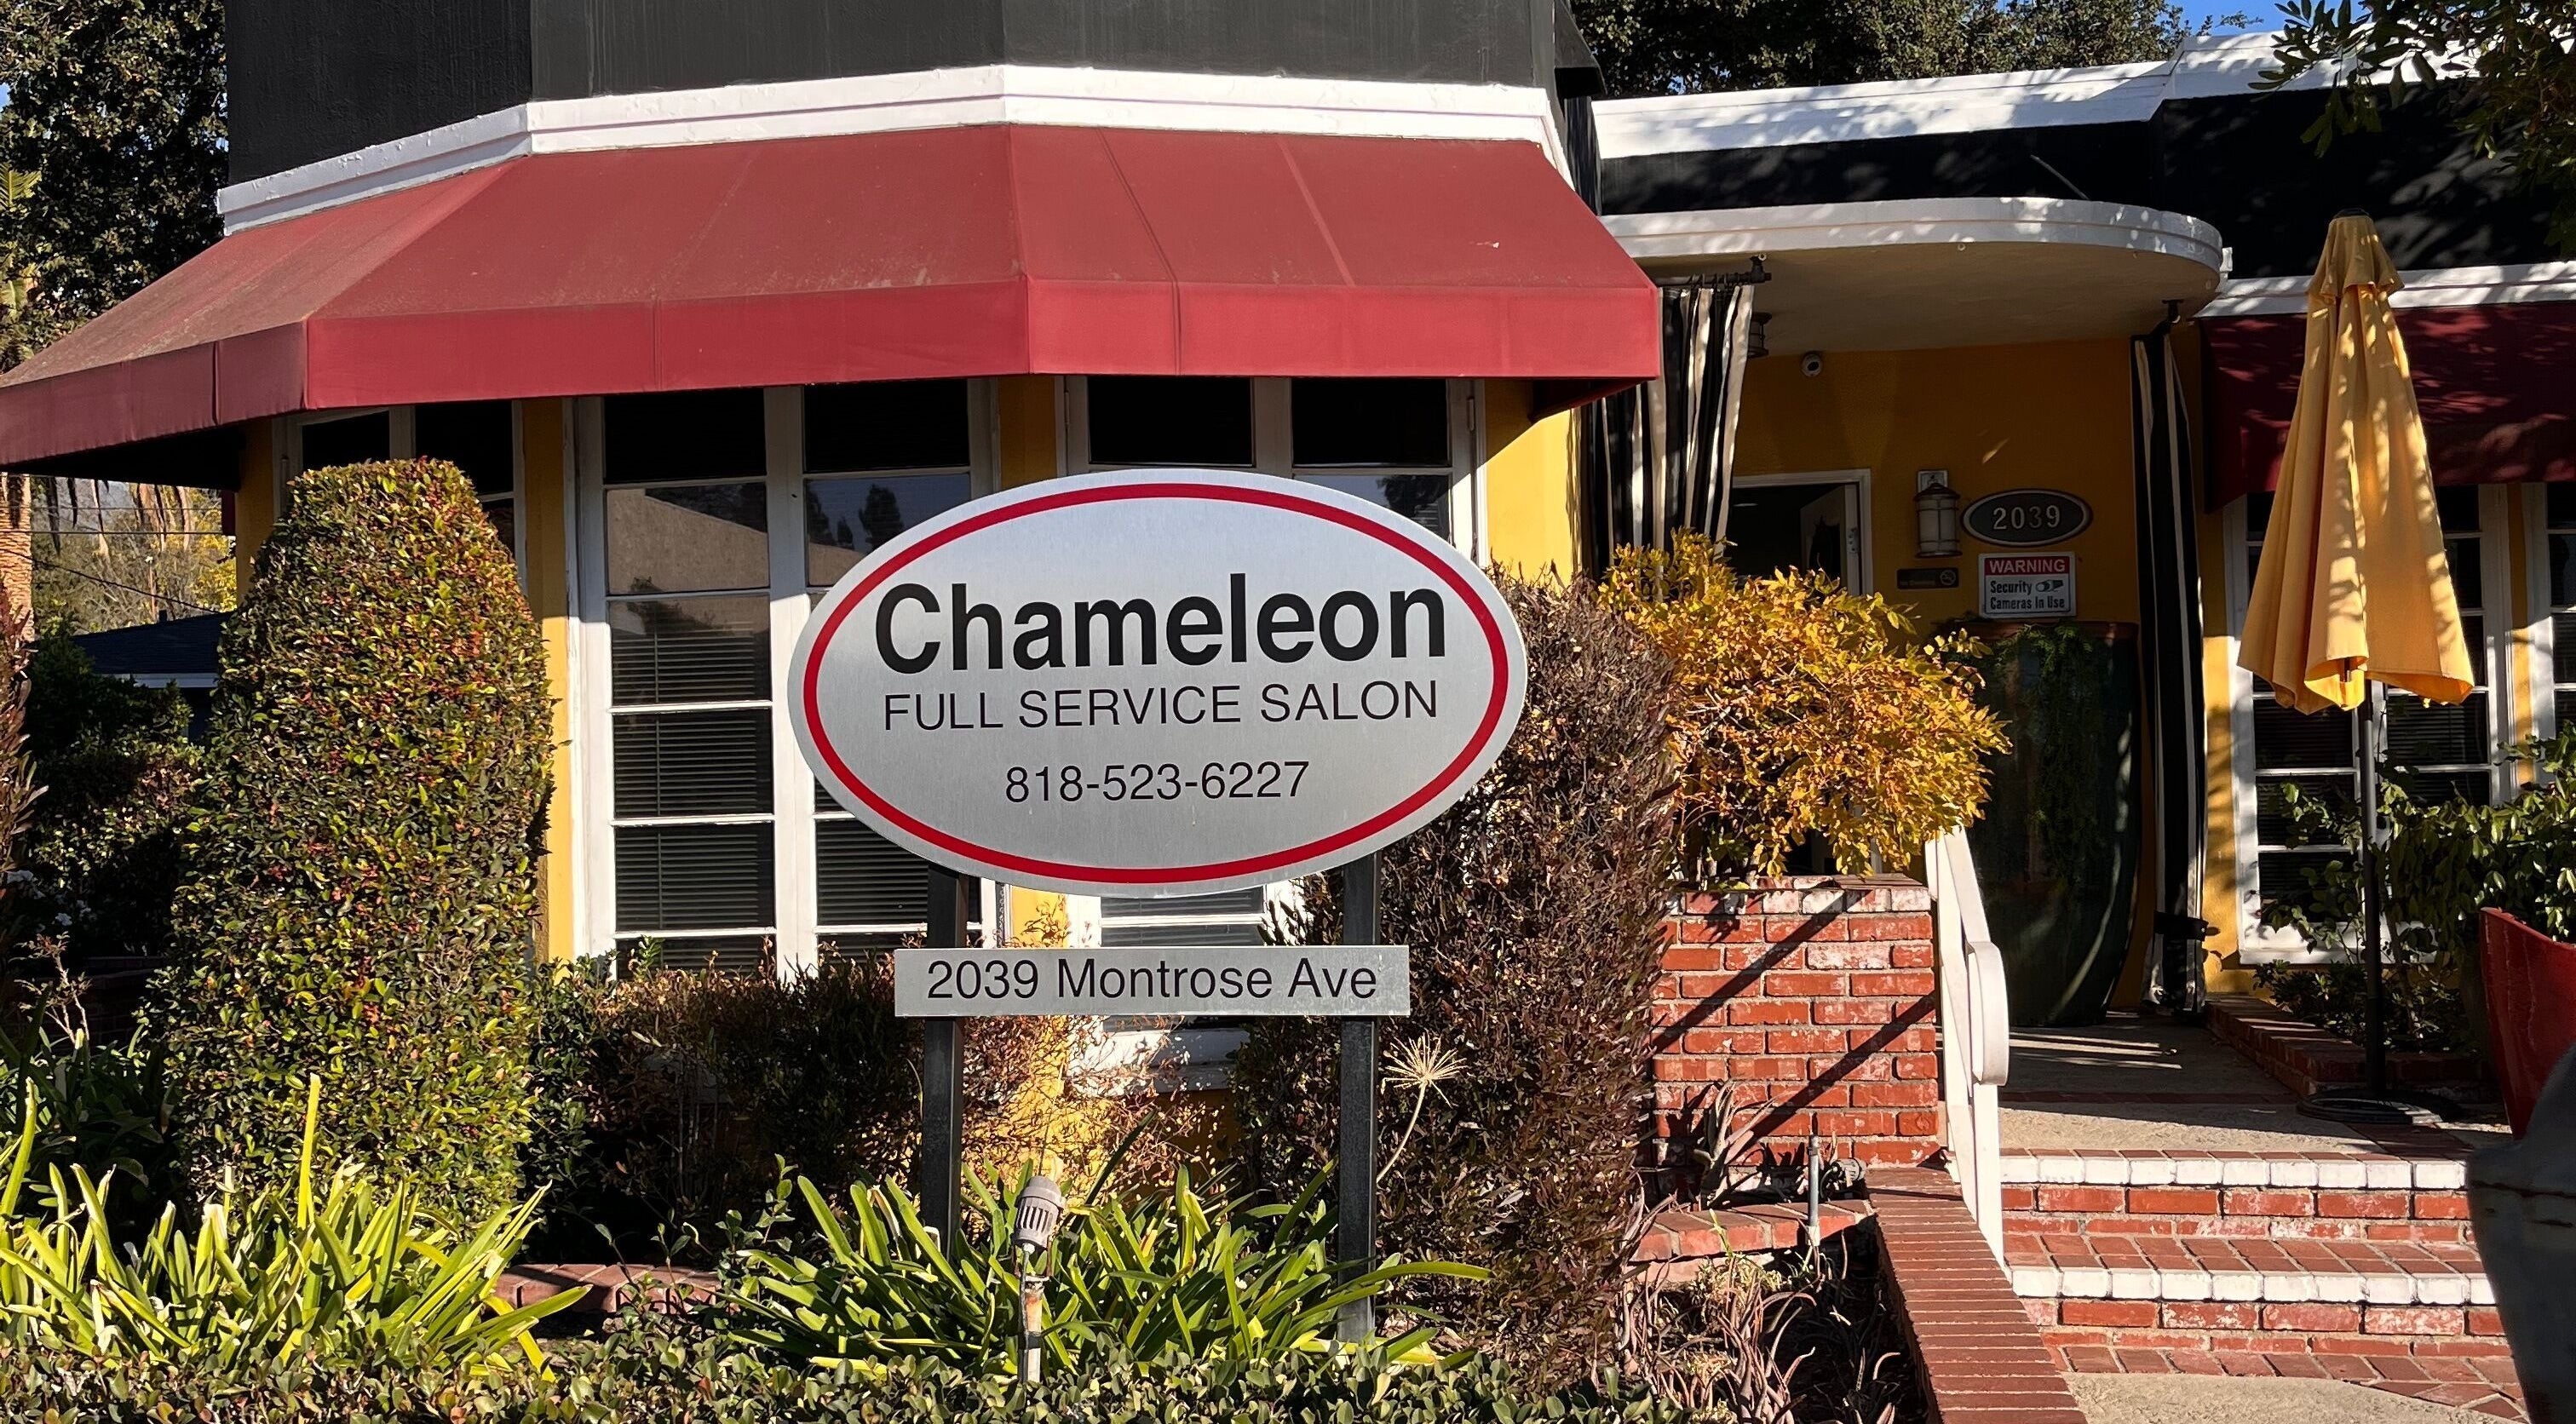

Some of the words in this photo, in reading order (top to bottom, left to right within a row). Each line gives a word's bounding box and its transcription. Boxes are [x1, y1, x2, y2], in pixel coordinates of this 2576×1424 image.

[1992, 505, 2061, 531] 2039
[1989, 559, 2066, 574] WARNING
[1990, 580, 2033, 595] Security
[1990, 597, 2033, 610] Cameras
[2035, 597, 2044, 609] In
[2047, 596, 2065, 608] Use
[876, 573, 1446, 674] Chameleon
[885, 692, 1003, 731] FULL
[1019, 686, 1241, 728] SERVICE
[1261, 680, 1436, 722] SALON
[1005, 761, 1309, 803] 818-523-6227
[928, 959, 1038, 999] 2039
[1058, 958, 1273, 999] Montrose
[1287, 957, 1377, 999] Ave
